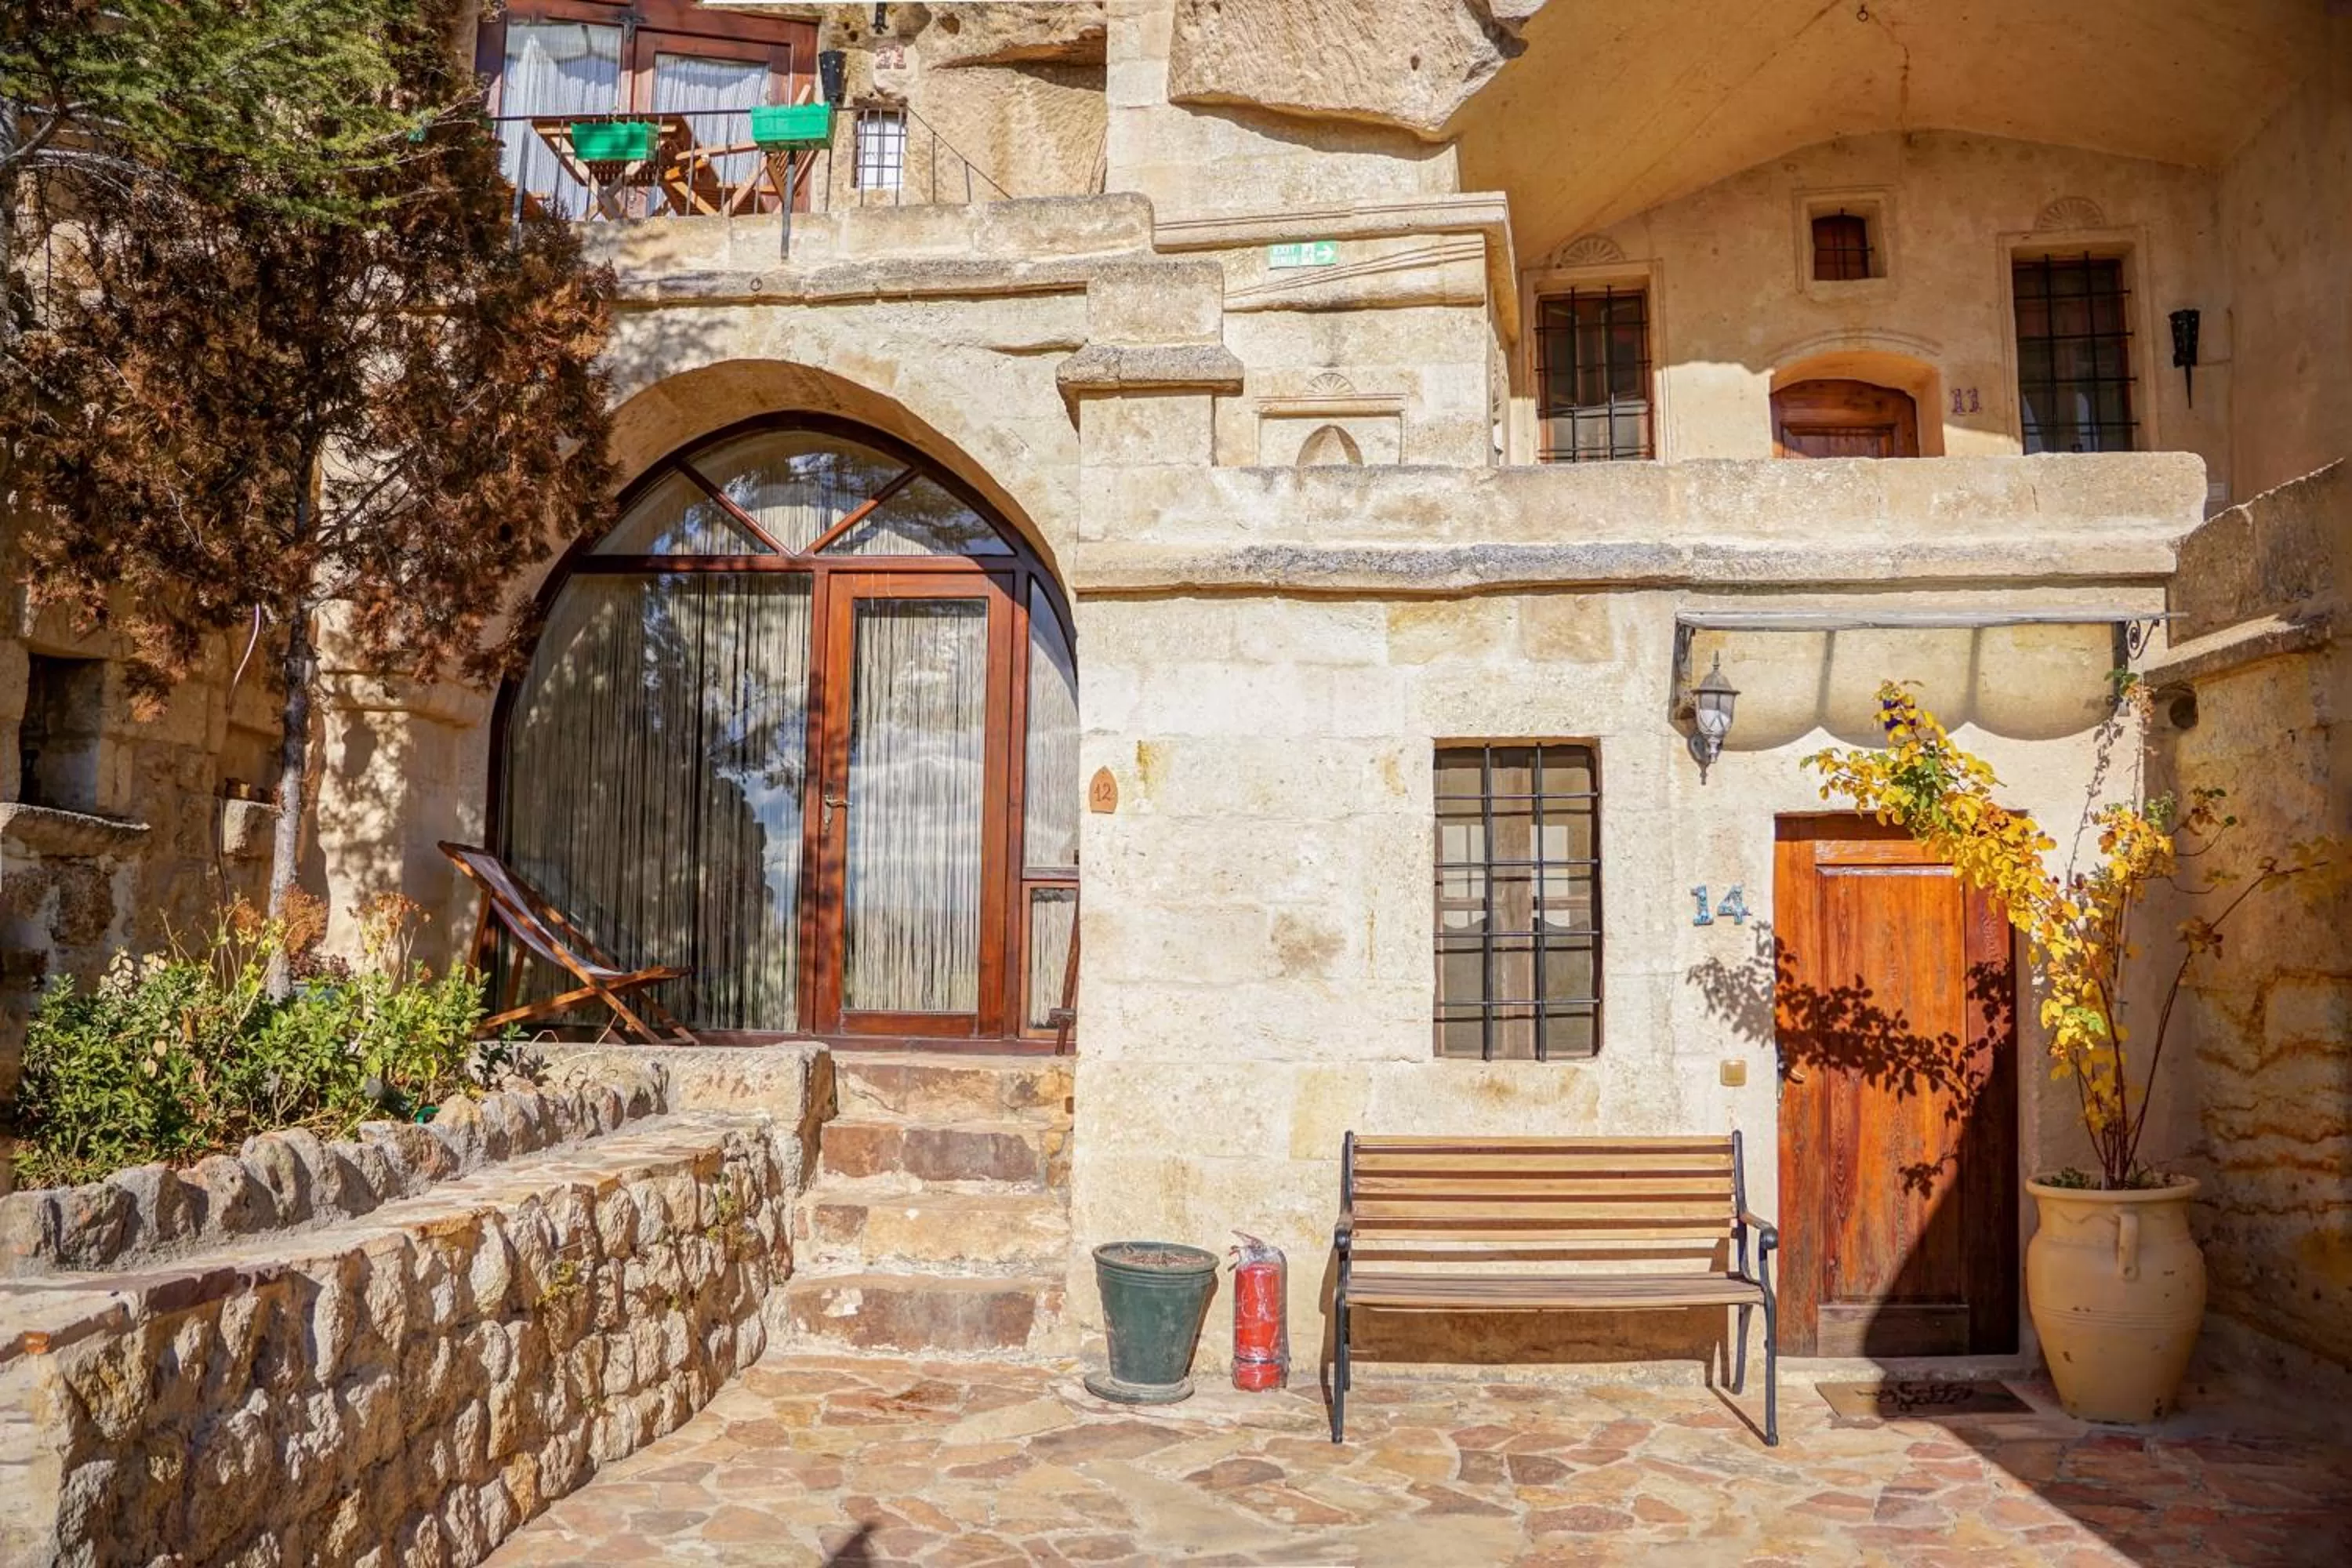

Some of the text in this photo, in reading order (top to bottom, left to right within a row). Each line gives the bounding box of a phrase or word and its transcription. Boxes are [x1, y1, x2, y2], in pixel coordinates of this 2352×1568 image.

[1951, 388, 1982, 415] 11
[1094, 782, 1112, 801] 12
[1691, 883, 1752, 926] 14
